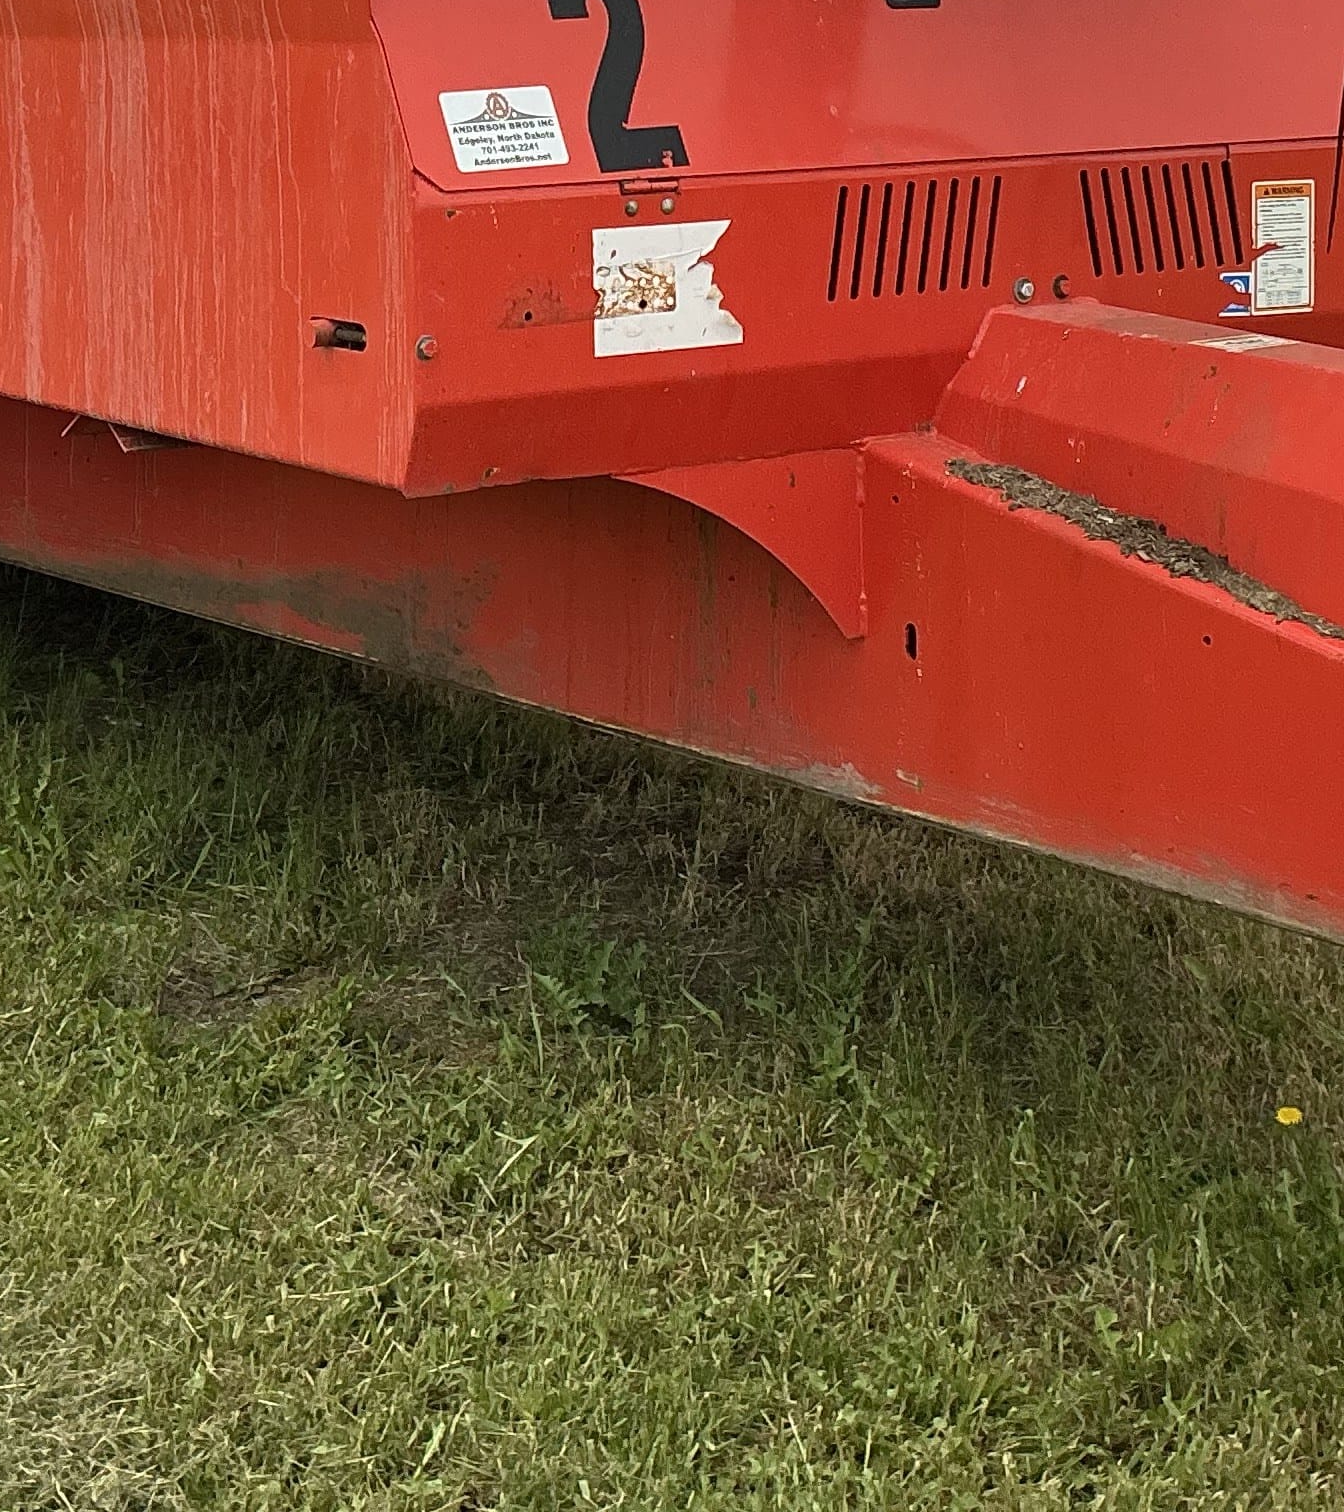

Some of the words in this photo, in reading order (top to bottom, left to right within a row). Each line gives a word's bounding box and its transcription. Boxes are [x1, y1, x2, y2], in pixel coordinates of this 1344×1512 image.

[453, 123, 506, 134] ANDERSON
[509, 120, 535, 129] BROS
[537, 119, 555, 127] INC
[498, 133, 523, 142] North
[525, 131, 555, 139] Dakota
